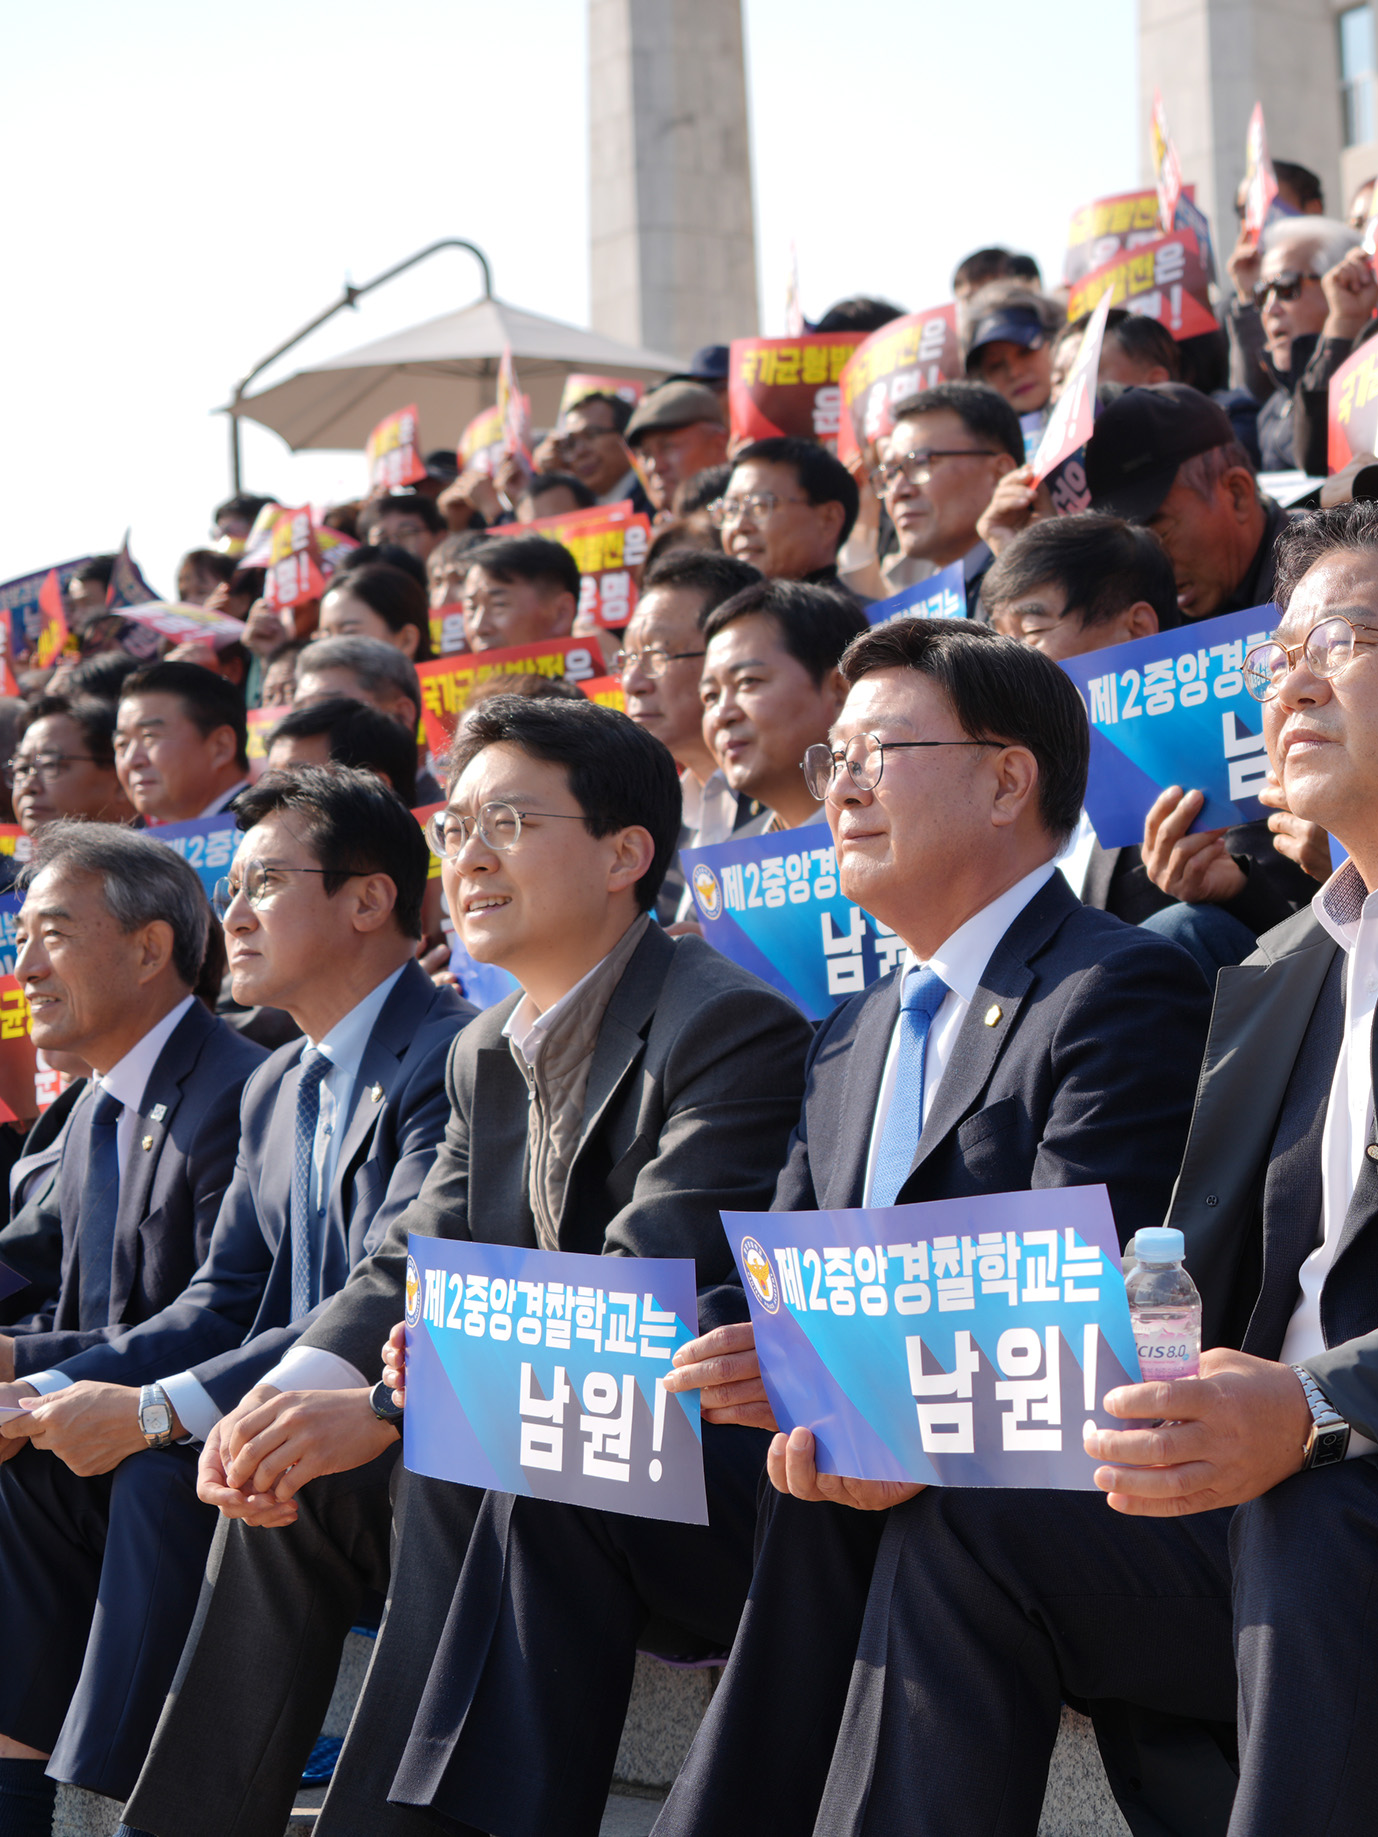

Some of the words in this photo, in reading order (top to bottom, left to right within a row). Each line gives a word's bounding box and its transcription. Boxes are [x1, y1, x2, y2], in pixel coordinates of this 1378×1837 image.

[1087, 631, 1277, 727] 제2중앙경
[423, 1269, 678, 1360] 제2중앙경찰학교는
[773, 1227, 1103, 1317] 제2중앙경찰학교는
[905, 1323, 1100, 1454] 남원!
[1135, 1343, 1165, 1358] CIS
[1166, 1344, 1187, 1359] 8.0
[519, 1361, 669, 1483] 남원!
